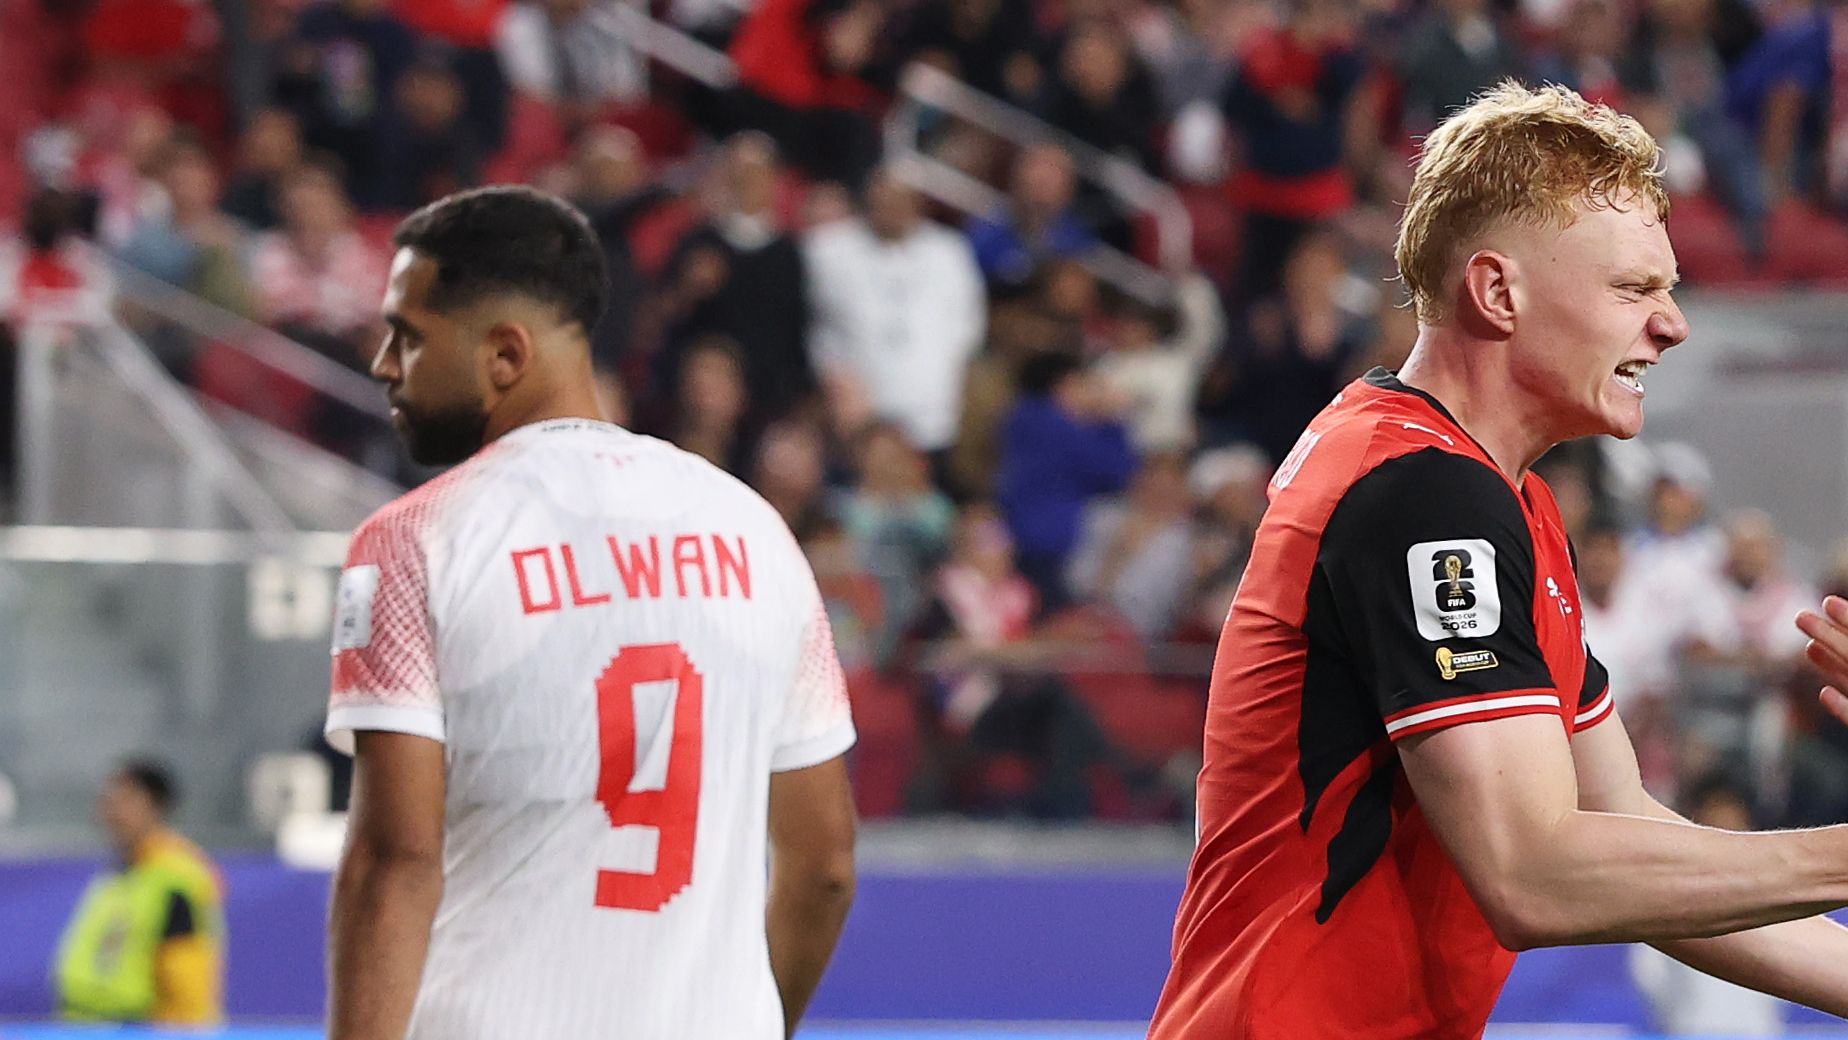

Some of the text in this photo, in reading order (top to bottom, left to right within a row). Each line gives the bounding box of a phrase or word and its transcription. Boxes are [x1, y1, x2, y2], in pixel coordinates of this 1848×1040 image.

[511, 533, 751, 615] OLWAN
[1447, 598, 1466, 607] FIFA
[1441, 620, 1477, 631] 2026
[1452, 652, 1490, 664] DEBUT
[594, 642, 703, 912] 9
